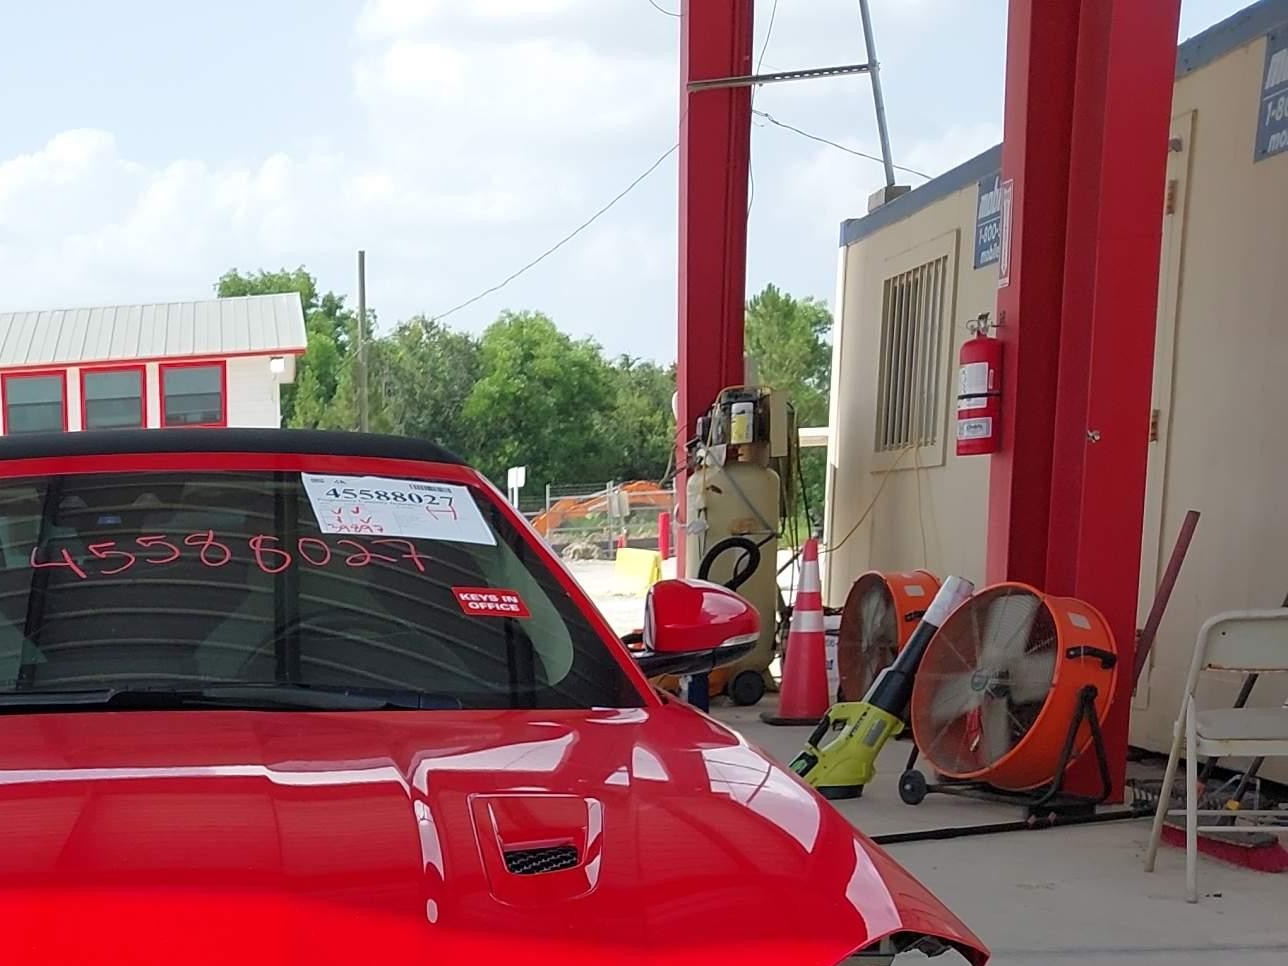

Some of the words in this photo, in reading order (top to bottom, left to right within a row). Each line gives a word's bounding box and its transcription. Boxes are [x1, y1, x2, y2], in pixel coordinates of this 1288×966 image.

[325, 487, 453, 507] 45588027
[30, 530, 432, 579] 45588027
[458, 592, 499, 603] KEYS
[501, 595, 519, 604] IN
[468, 602, 521, 612] OFFICE
